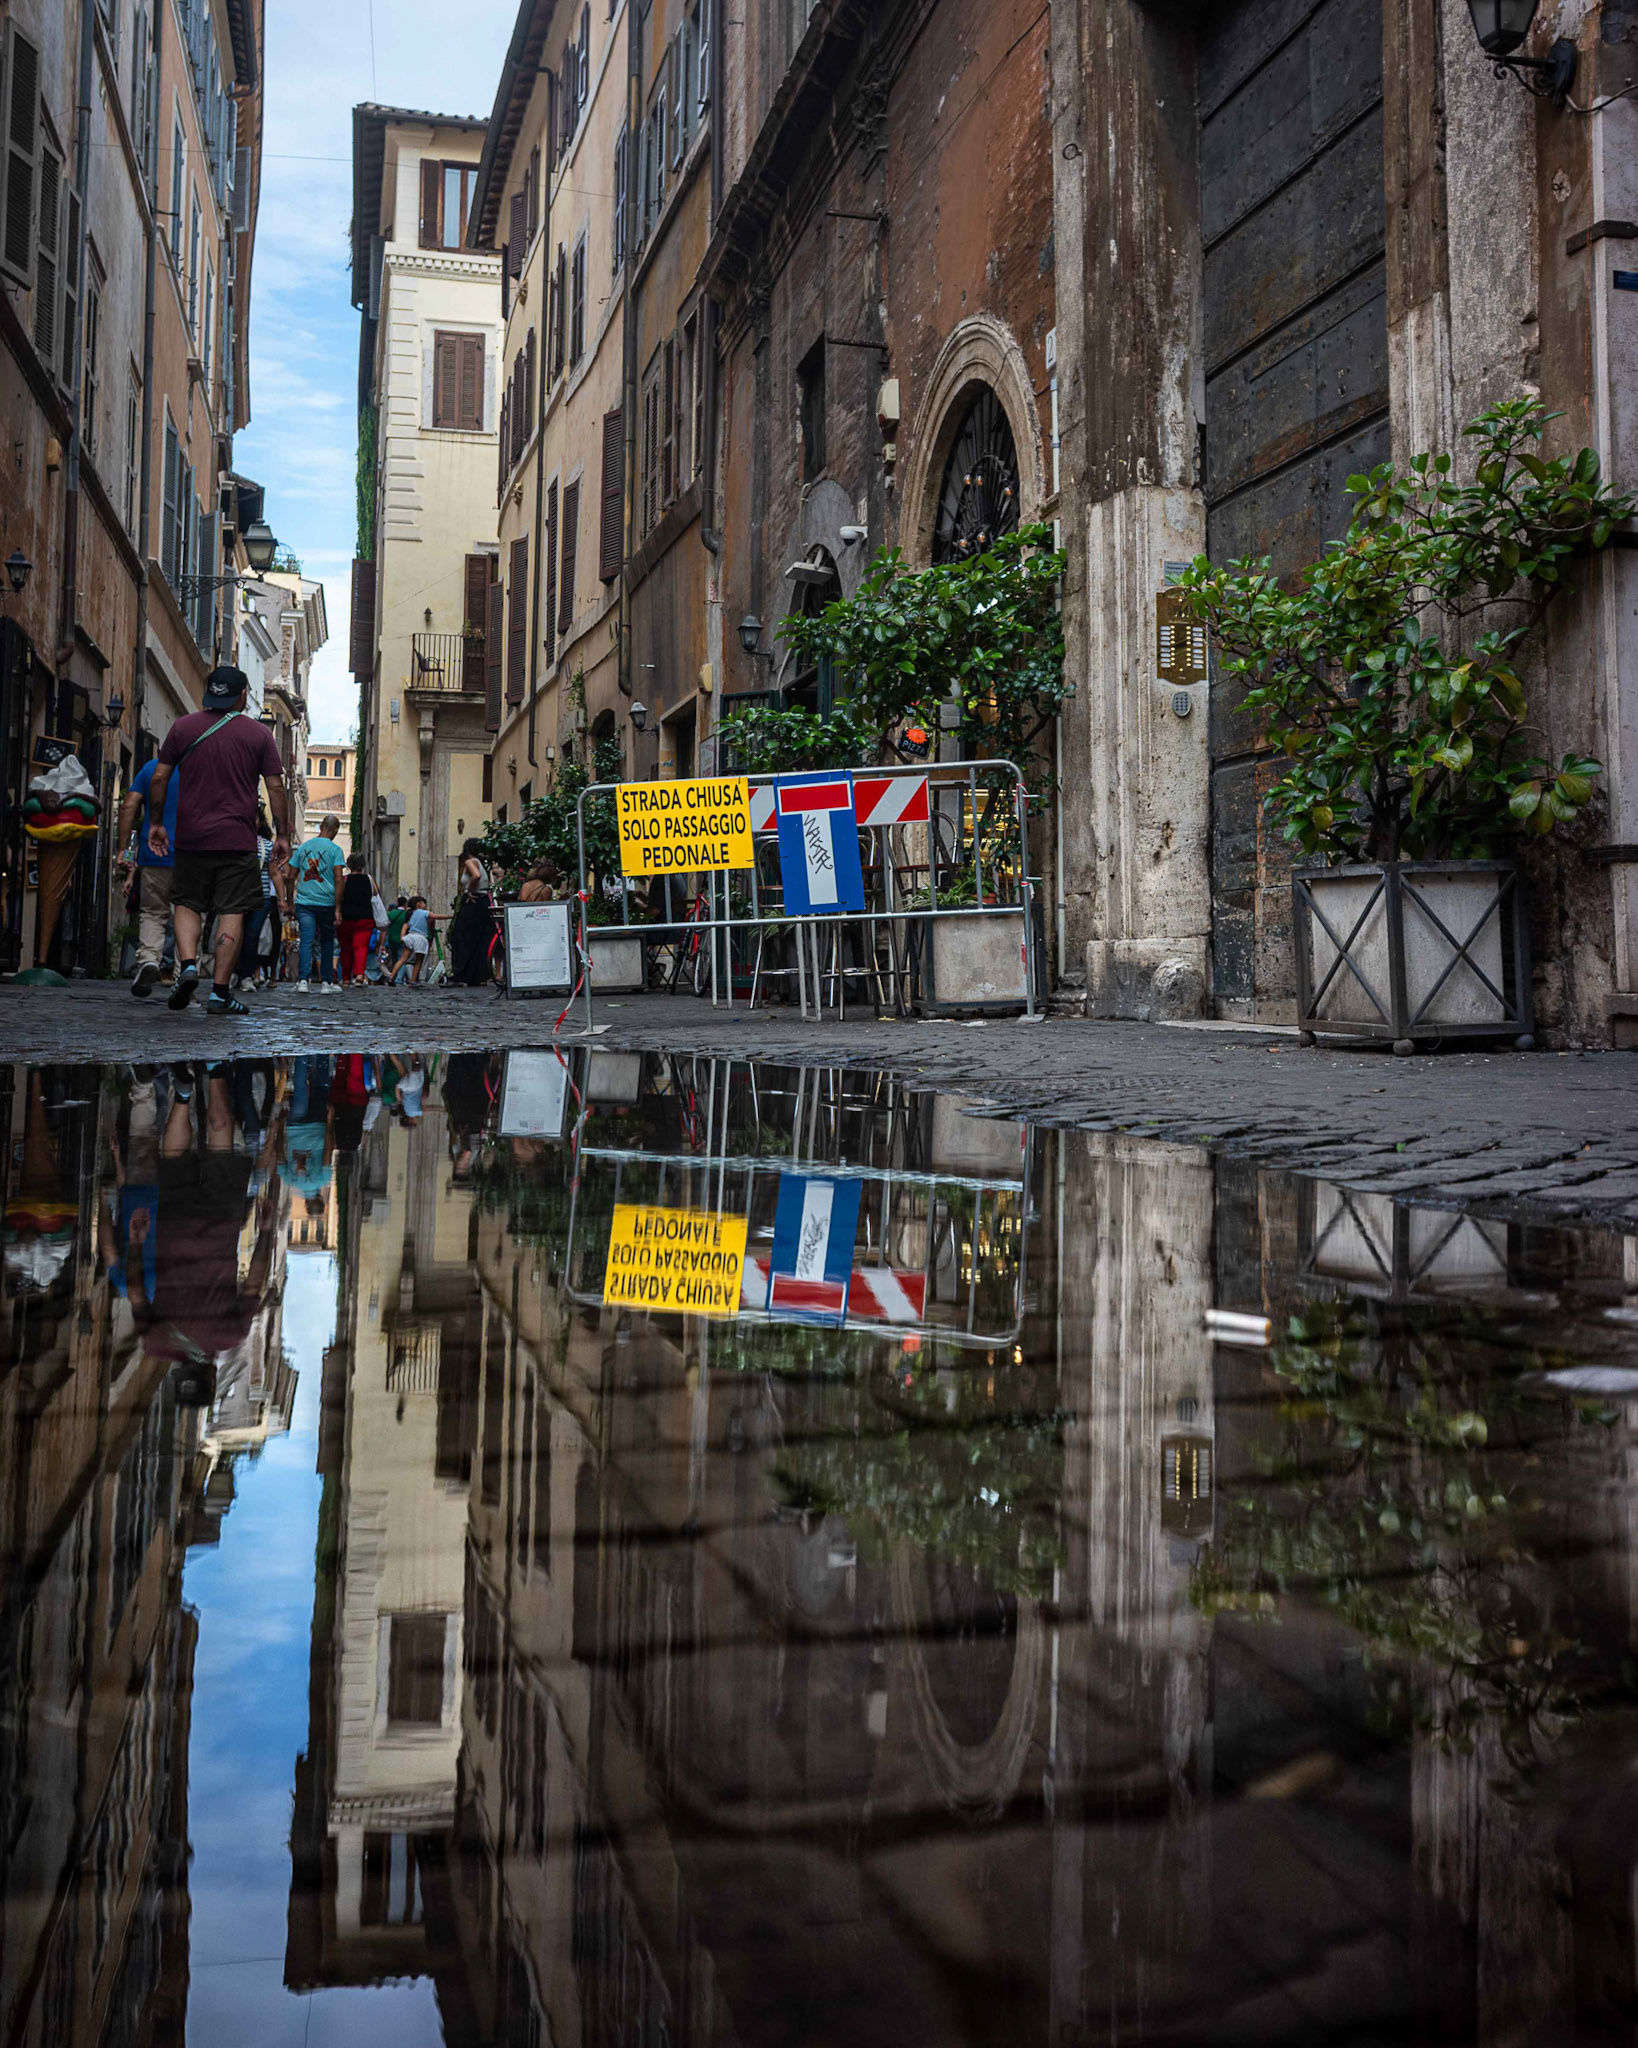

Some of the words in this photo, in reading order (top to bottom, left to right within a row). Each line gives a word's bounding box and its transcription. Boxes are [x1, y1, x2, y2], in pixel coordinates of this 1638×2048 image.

[902, 740, 926, 755] PIZZA
[622, 788, 682, 812] STRADA
[686, 784, 743, 809] CHIUSA
[623, 818, 660, 841] SOLO
[665, 812, 746, 838] PASSAGGIO
[643, 843, 730, 868] PEDONALE
